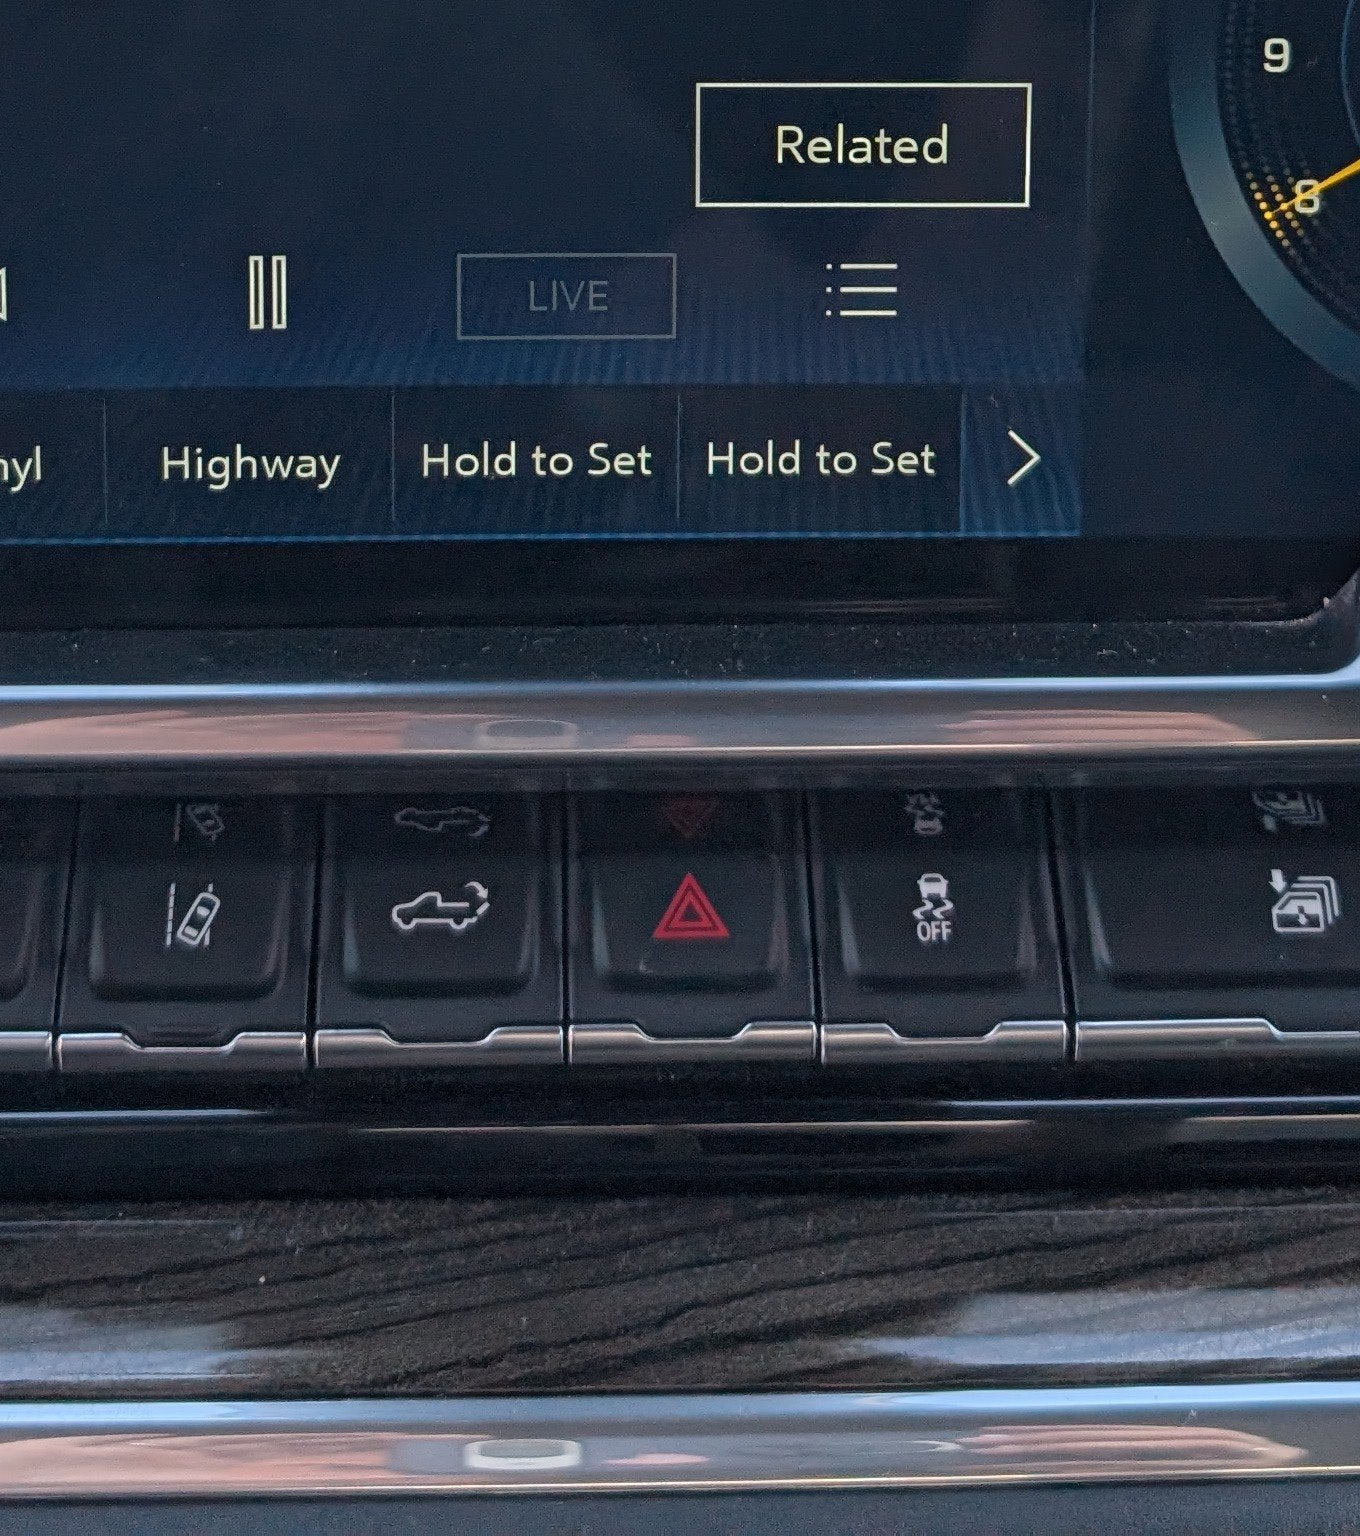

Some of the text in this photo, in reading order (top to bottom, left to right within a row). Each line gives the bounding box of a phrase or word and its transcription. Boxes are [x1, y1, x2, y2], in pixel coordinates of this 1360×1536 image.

[1263, 37, 1291, 74] 9
[776, 122, 949, 165] Related
[1294, 179, 1321, 215] 8
[528, 278, 609, 313] LIVE
[162, 443, 342, 491] Highway
[422, 440, 653, 478] Hold to Set
[706, 438, 936, 476] Hold to Set
[915, 919, 953, 943] OFF
